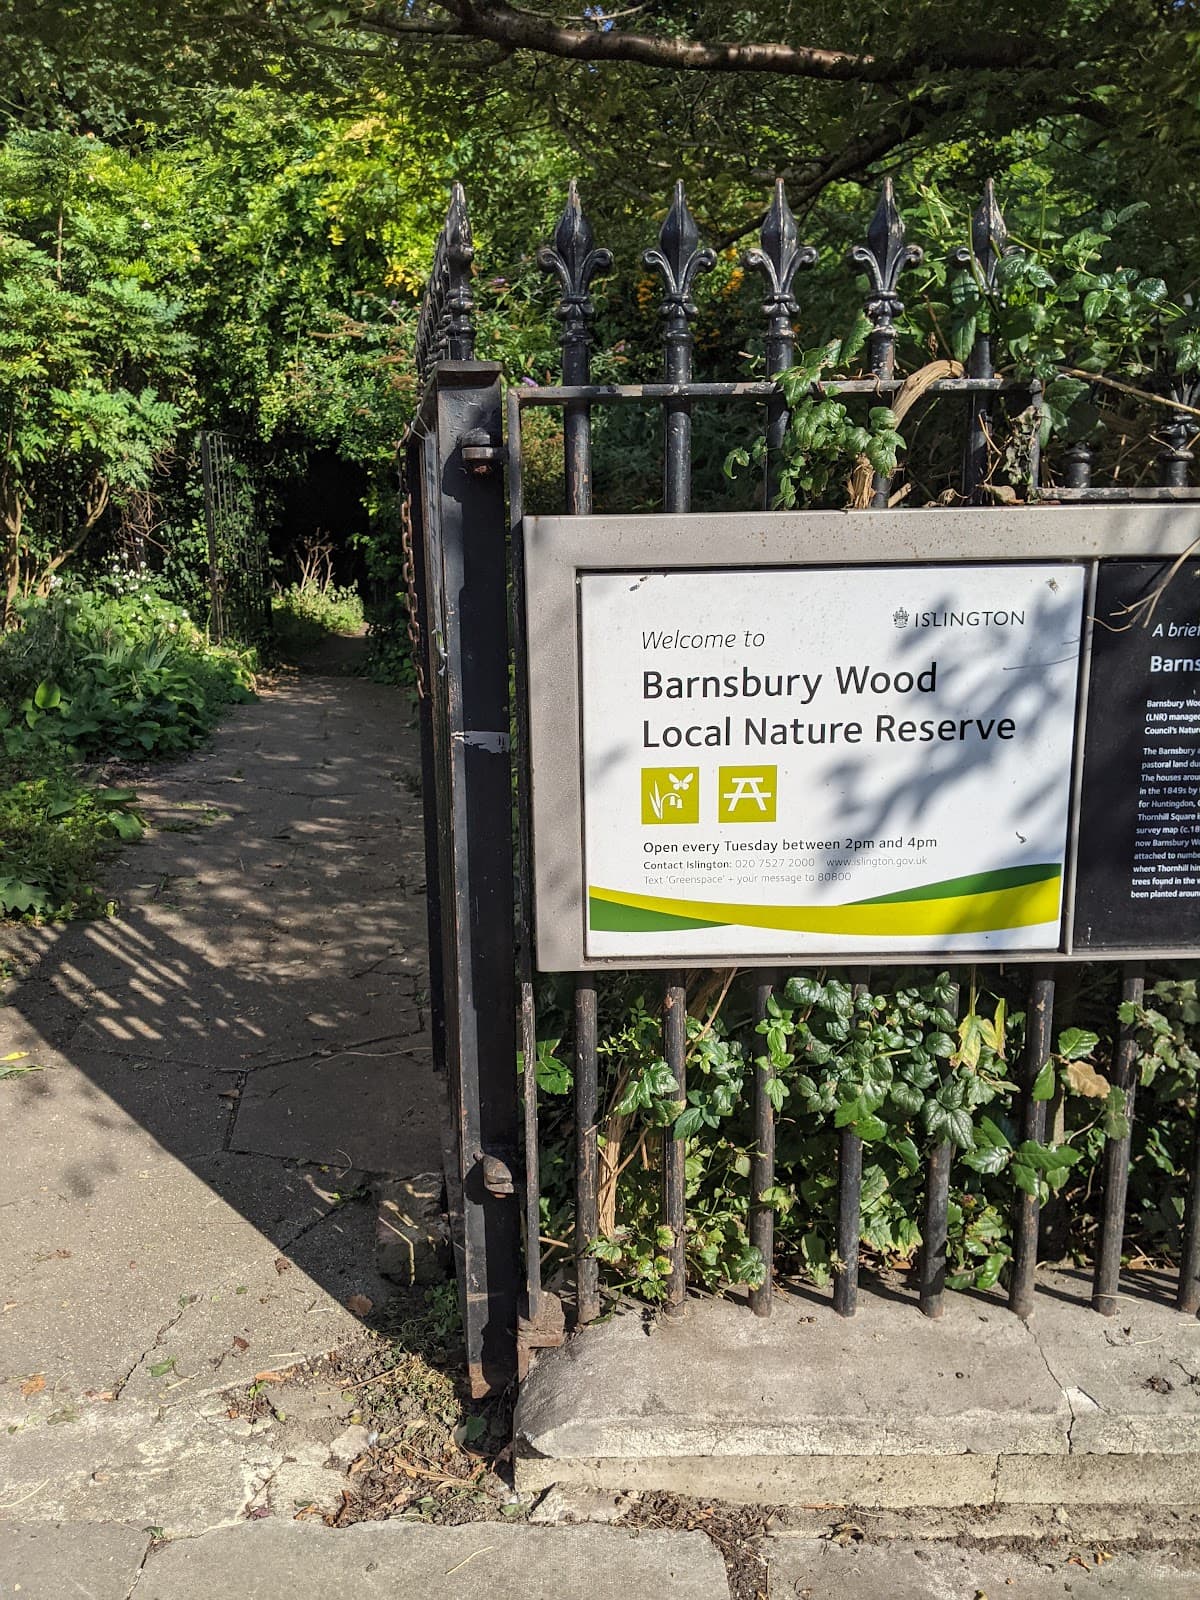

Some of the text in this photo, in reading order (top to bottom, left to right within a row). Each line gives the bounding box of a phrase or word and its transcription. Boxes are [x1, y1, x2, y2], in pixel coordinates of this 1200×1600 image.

[914, 610, 1026, 628] ISLINGTON
[1152, 623, 1164, 638] A
[642, 629, 766, 650] Welcome to
[1150, 655, 1200, 672] Barns
[642, 662, 938, 704] Barnsbury Wood
[1146, 699, 1184, 708] Barnsbury
[1146, 713, 1168, 722] (LNR)
[642, 714, 1016, 748] Local Nature Reserve
[1144, 726, 1200, 734] Council's Natur
[1143, 748, 1157, 756] The
[1158, 746, 1196, 756] Barnsbury
[1142, 760, 1172, 770] pastoral
[1172, 760, 1188, 768] land
[1141, 774, 1156, 782] The
[1156, 774, 1182, 782] houses
[1148, 787, 1160, 795] the
[1188, 786, 1198, 796] by
[1138, 800, 1150, 808] for
[1138, 813, 1170, 821] Thornhill
[1170, 812, 1196, 822] Square
[1136, 828, 1162, 836] survey
[1162, 827, 1178, 835] map
[643, 836, 937, 855] Open every Tuesday between 2pm and 4pm
[1152, 839, 1190, 848] Barnsbury
[1134, 852, 1166, 860] attached
[643, 861, 684, 870] Contact
[686, 860, 732, 870] Islington:
[735, 859, 756, 868] 020
[760, 858, 785, 868] 7527
[788, 858, 815, 867] 2000
[1158, 864, 1189, 872] Thornhill
[645, 876, 664, 884] Text
[737, 874, 758, 884] your
[761, 873, 802, 884] message
[805, 873, 815, 882] to
[818, 872, 852, 882] 80800
[1152, 877, 1174, 885] found
[1174, 876, 1182, 884] in
[1183, 876, 1196, 884] the
[1130, 890, 1149, 898] been
[1150, 889, 1178, 899] planted
